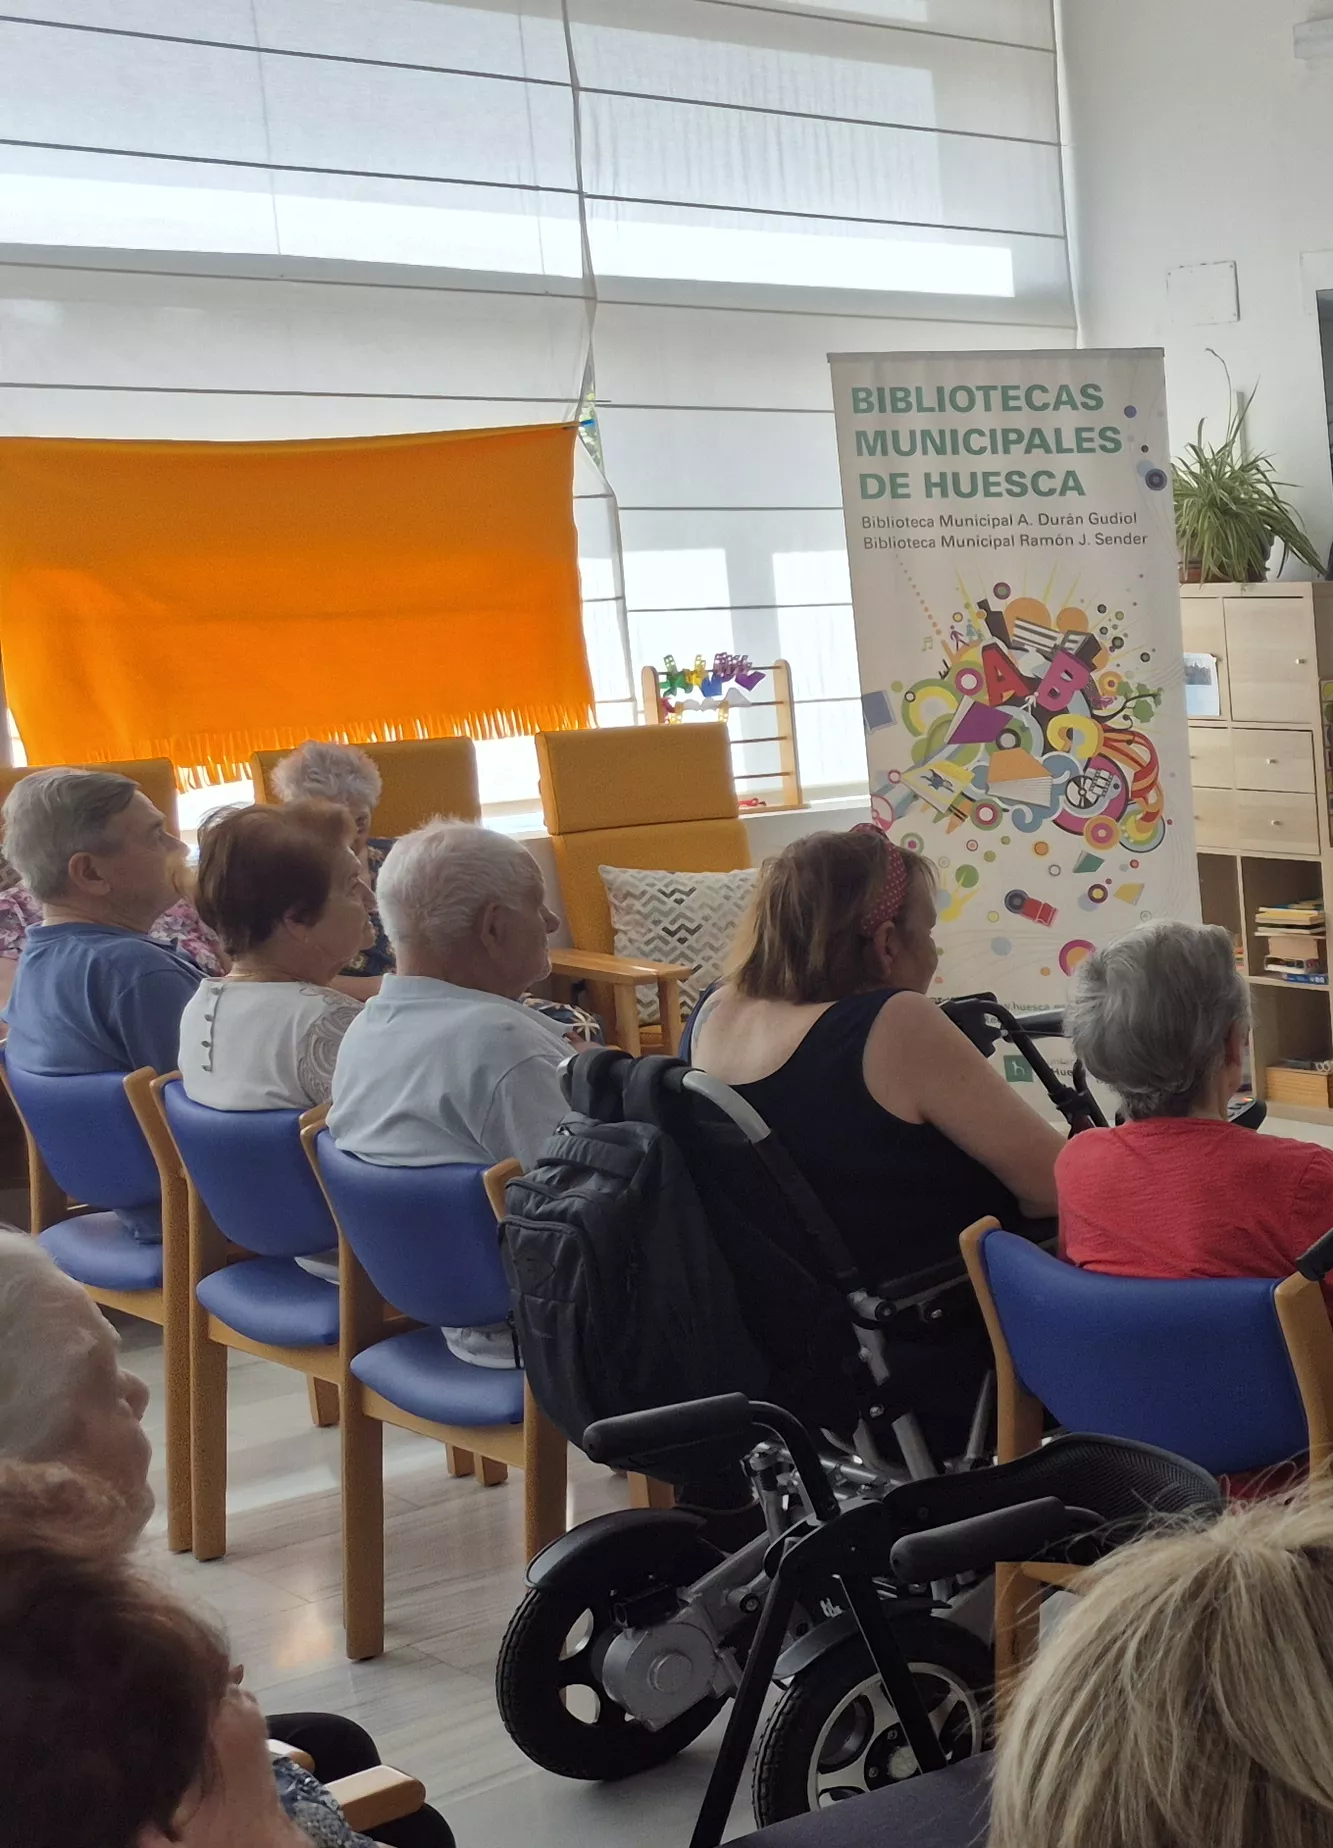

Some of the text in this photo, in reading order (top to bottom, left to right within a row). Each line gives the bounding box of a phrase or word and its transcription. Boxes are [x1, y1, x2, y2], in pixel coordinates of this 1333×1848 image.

[851, 383, 1104, 414] BIBLIOTECAS
[855, 426, 1122, 457] MUNICIPALES
[859, 470, 1086, 499] DE HUESCA
[862, 511, 1137, 530] Biblioteca Municipal A. Durán Gudiol
[863, 532, 1148, 550] Biblioteca Municipal Ramón J. Sender
